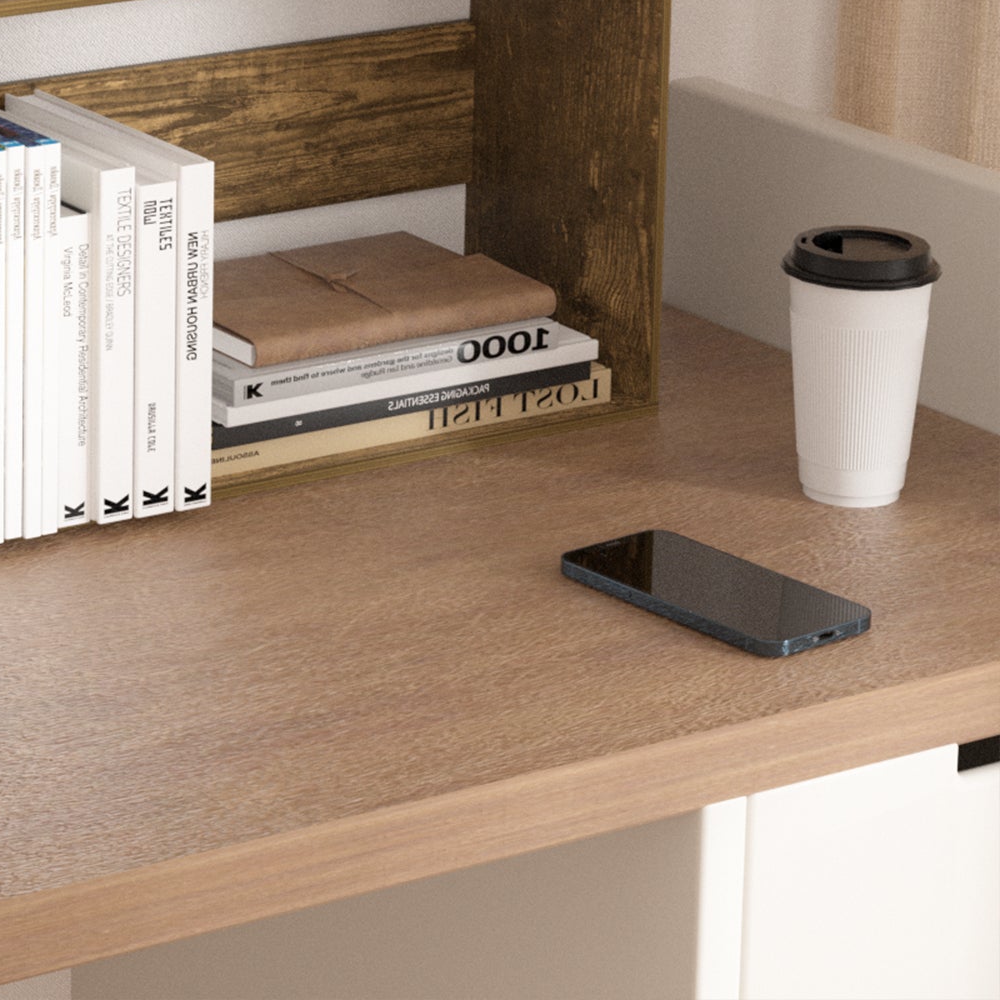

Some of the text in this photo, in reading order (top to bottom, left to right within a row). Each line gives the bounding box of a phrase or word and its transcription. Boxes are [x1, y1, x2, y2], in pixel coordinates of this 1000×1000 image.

[116, 188, 132, 297] TEXTILE DESIGNERS
[159, 198, 173, 251] TEXTILES
[61, 247, 73, 317] Virginia McLeod
[76, 243, 89, 447] Detail in Contemporary Residential Architecture
[64, 502, 85, 518] K
[104, 494, 130, 515] K
[143, 486, 168, 506] K
[184, 483, 207, 502] K
